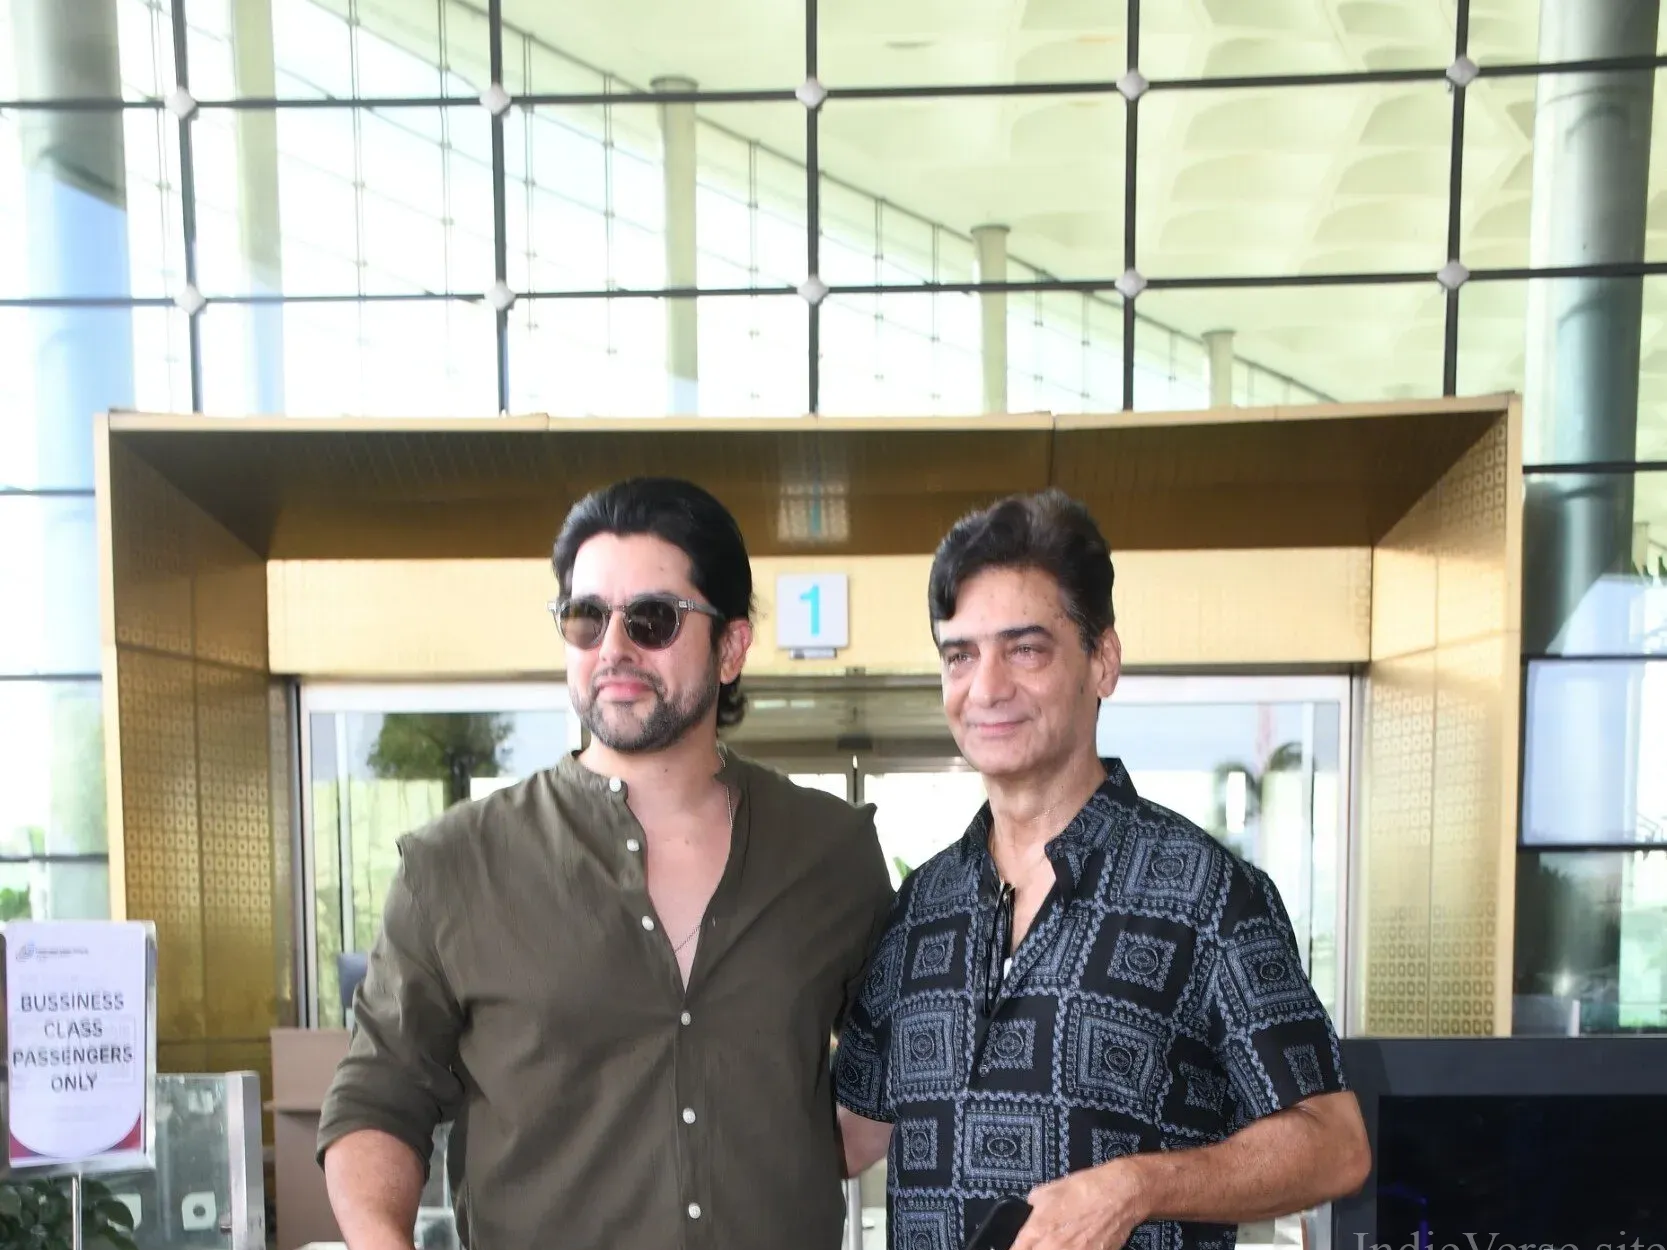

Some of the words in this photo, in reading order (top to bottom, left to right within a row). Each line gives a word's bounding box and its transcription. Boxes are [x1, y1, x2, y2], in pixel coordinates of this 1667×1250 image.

[799, 584, 820, 636] 1
[20, 992, 124, 1012] BUSSINESS
[44, 1019, 103, 1038] CLASS
[12, 1046, 133, 1067] PASSENGERS
[51, 1073, 97, 1091] ONLY
